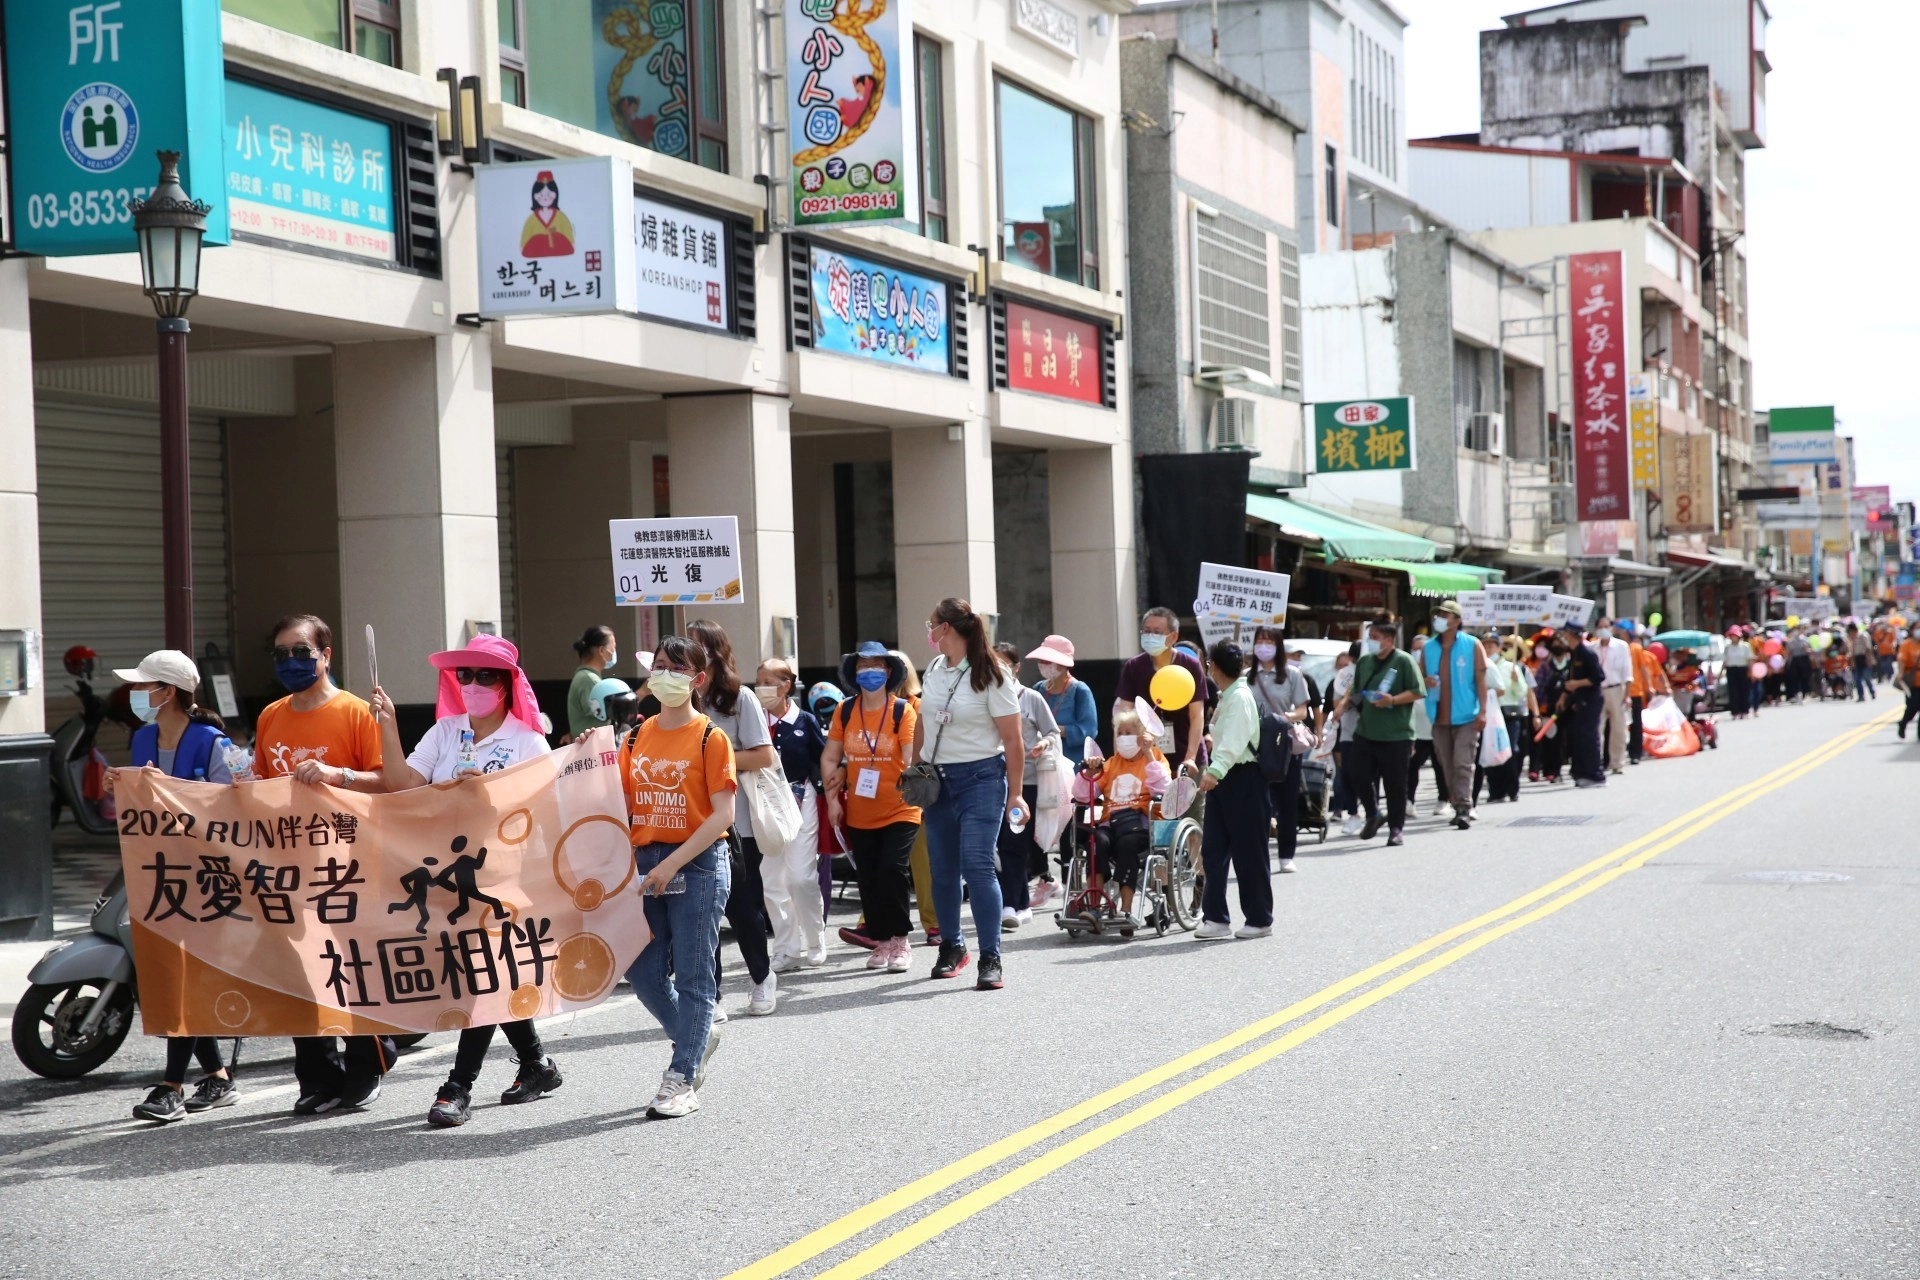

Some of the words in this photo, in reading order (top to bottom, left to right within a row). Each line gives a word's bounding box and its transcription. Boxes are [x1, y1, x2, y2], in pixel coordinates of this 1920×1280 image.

[68, 0, 124, 65] 所
[236, 115, 385, 193] 小兒科診所
[800, 157, 896, 193] 親子民宿
[801, 193, 897, 215] 0921-098141
[497, 260, 542, 286] 한국
[642, 268, 703, 294] KOREANSHOP
[540, 275, 601, 302] 며느리
[1344, 405, 1379, 422] 田家
[1321, 425, 1405, 470] 檳榔
[1771, 437, 1834, 451] FamilyMart
[634, 529, 713, 543] 佛教慈濟醫療財團法人
[620, 545, 731, 560] 花蓮慈濟醫院失智社區服務據點
[620, 575, 642, 593] 01
[1195, 601, 1210, 613] 04
[120, 808, 198, 839] 2022
[142, 851, 367, 924] 友愛智者
[319, 917, 558, 1007] 社區相伴
